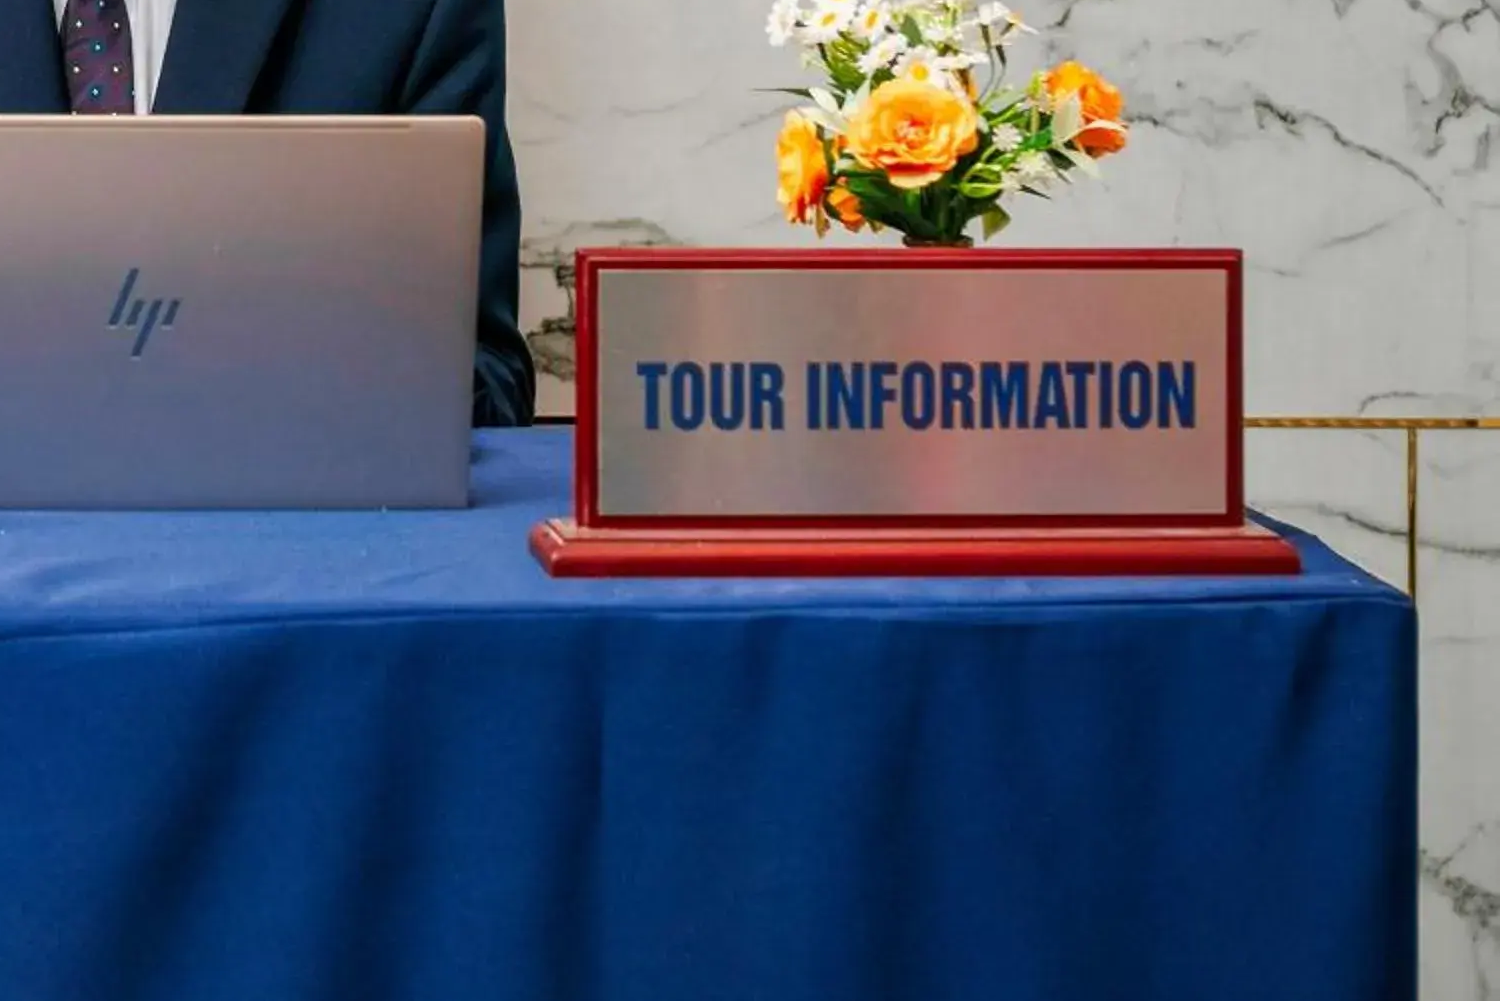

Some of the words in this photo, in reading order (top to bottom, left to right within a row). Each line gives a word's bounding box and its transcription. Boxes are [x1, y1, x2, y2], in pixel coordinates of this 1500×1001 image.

[108, 267, 181, 357] hp
[636, 360, 786, 431] TOUR
[806, 360, 1196, 431] INFORMATION
